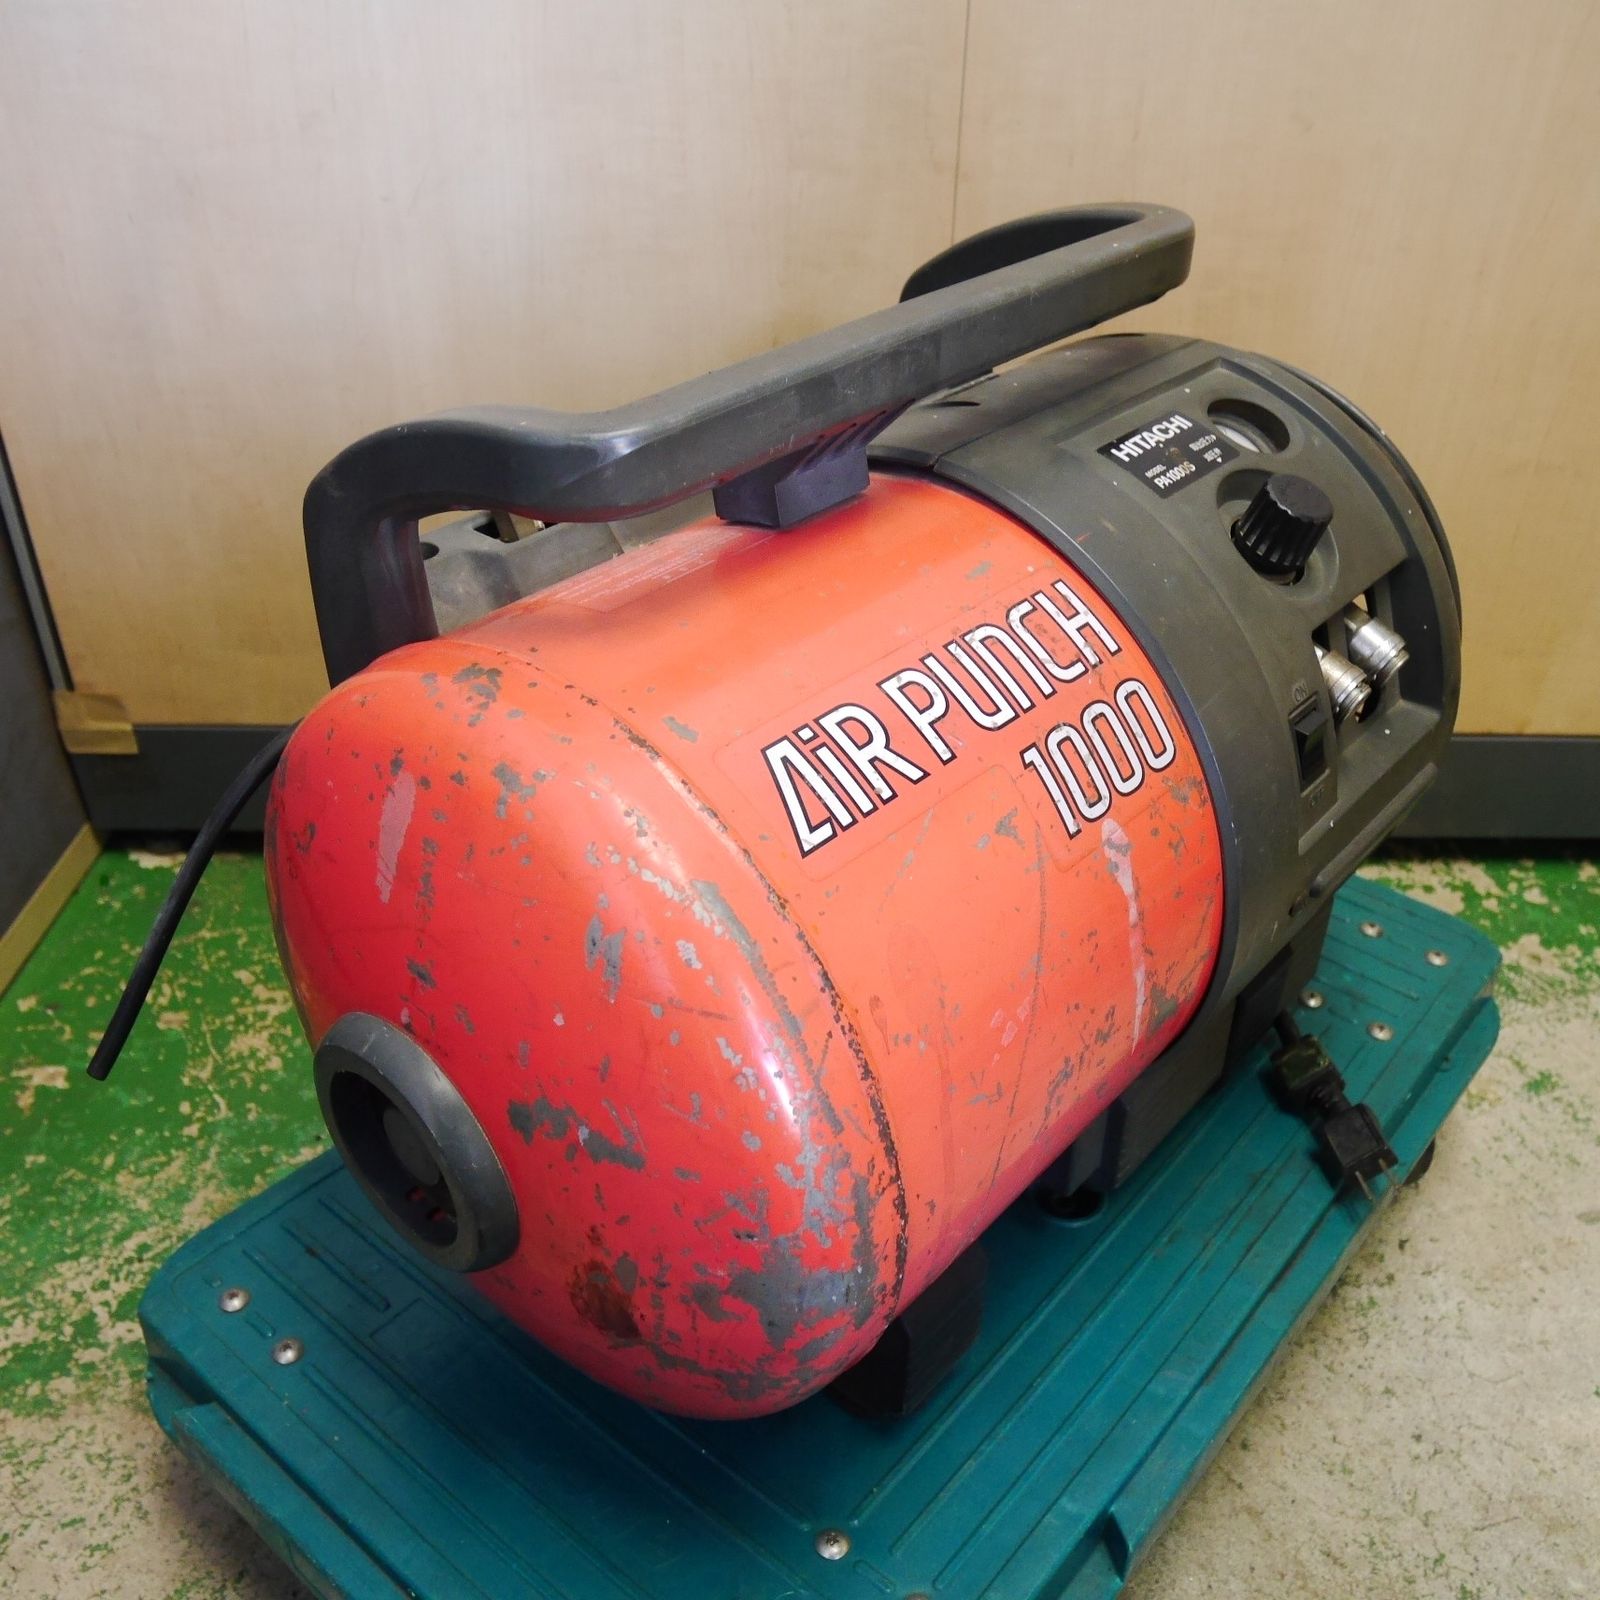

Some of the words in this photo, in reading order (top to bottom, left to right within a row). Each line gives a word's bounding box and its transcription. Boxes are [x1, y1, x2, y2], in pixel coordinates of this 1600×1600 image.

[1111, 415, 1193, 462] HITACHI
[1154, 461, 1196, 489] PA1000S
[1294, 683, 1307, 703] ON
[1019, 677, 1176, 840] 1000
